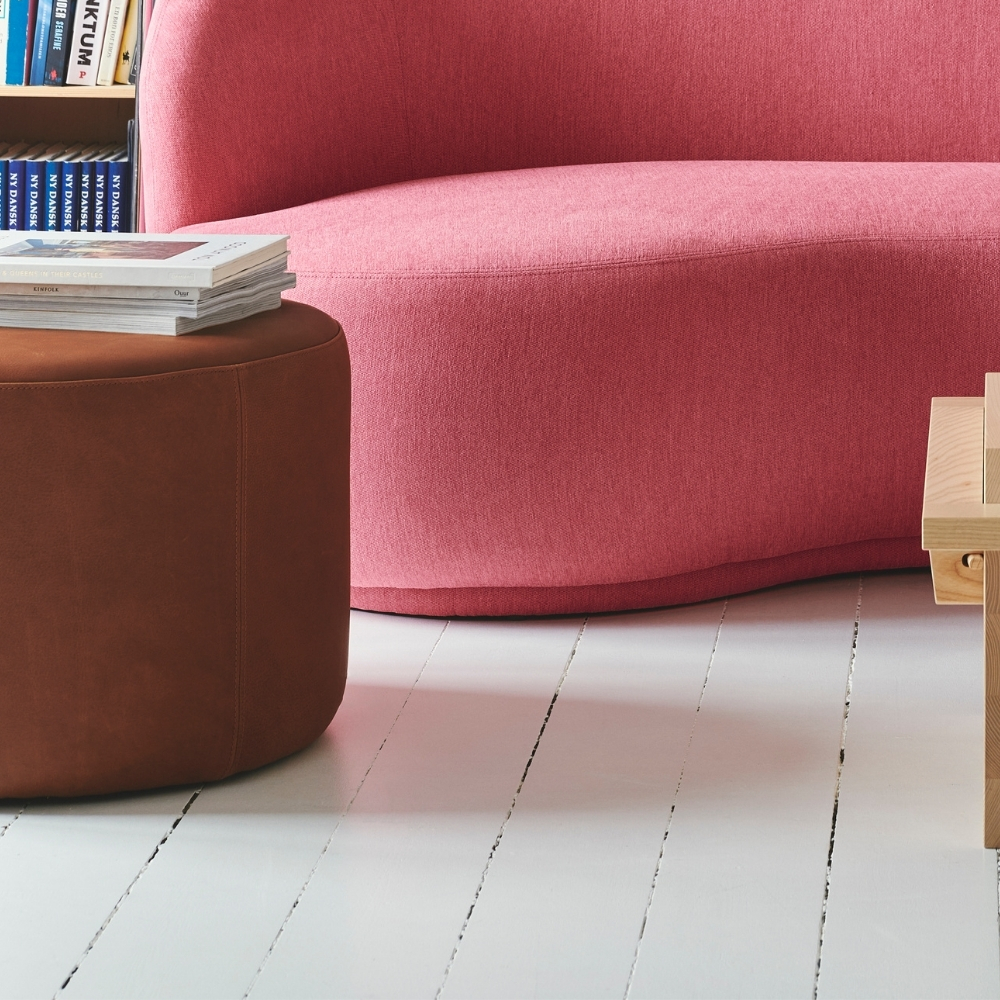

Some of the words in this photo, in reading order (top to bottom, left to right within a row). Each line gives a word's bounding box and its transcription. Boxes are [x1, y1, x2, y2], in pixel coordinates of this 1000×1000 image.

[52, 21, 64, 50] SERAFINE
[10, 173, 17, 188] NY
[31, 174, 38, 189] NY
[50, 174, 57, 189] NY
[65, 173, 73, 189] NY
[81, 174, 89, 189] NY
[96, 174, 104, 189] NY
[112, 175, 120, 189] NY
[9, 189, 17, 226] DANSK
[30, 191, 38, 227] DANSK
[48, 190, 57, 227] DANSK
[64, 190, 72, 226] DANSK
[95, 191, 104, 227] DANSK
[111, 191, 120, 227] DANSK
